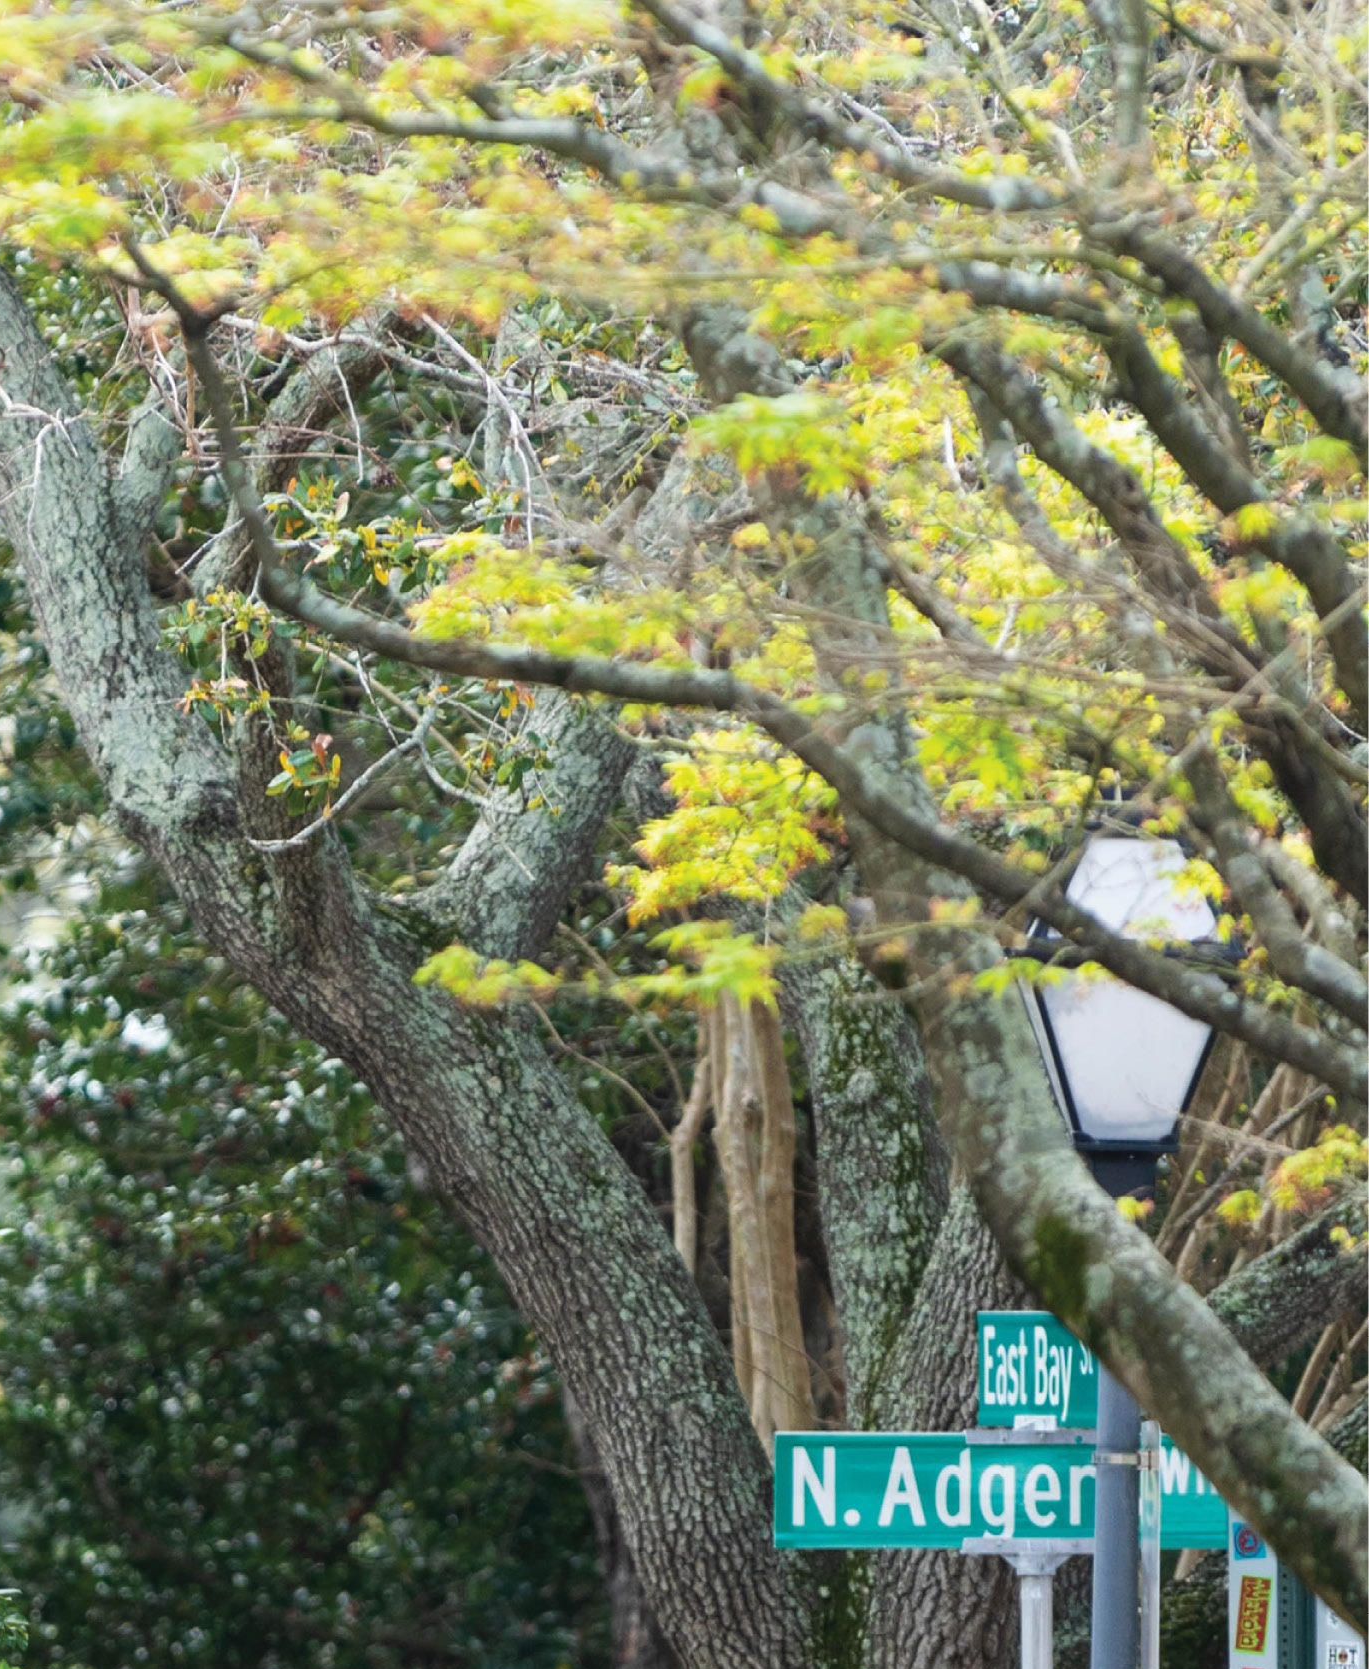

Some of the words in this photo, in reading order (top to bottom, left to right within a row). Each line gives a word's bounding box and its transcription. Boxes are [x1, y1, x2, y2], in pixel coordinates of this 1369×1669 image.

[983, 1325, 1028, 1406] East
[1034, 1325, 1073, 1422] Bay
[792, 1446, 861, 1526] N.
[878, 1446, 1095, 1538] Adger
